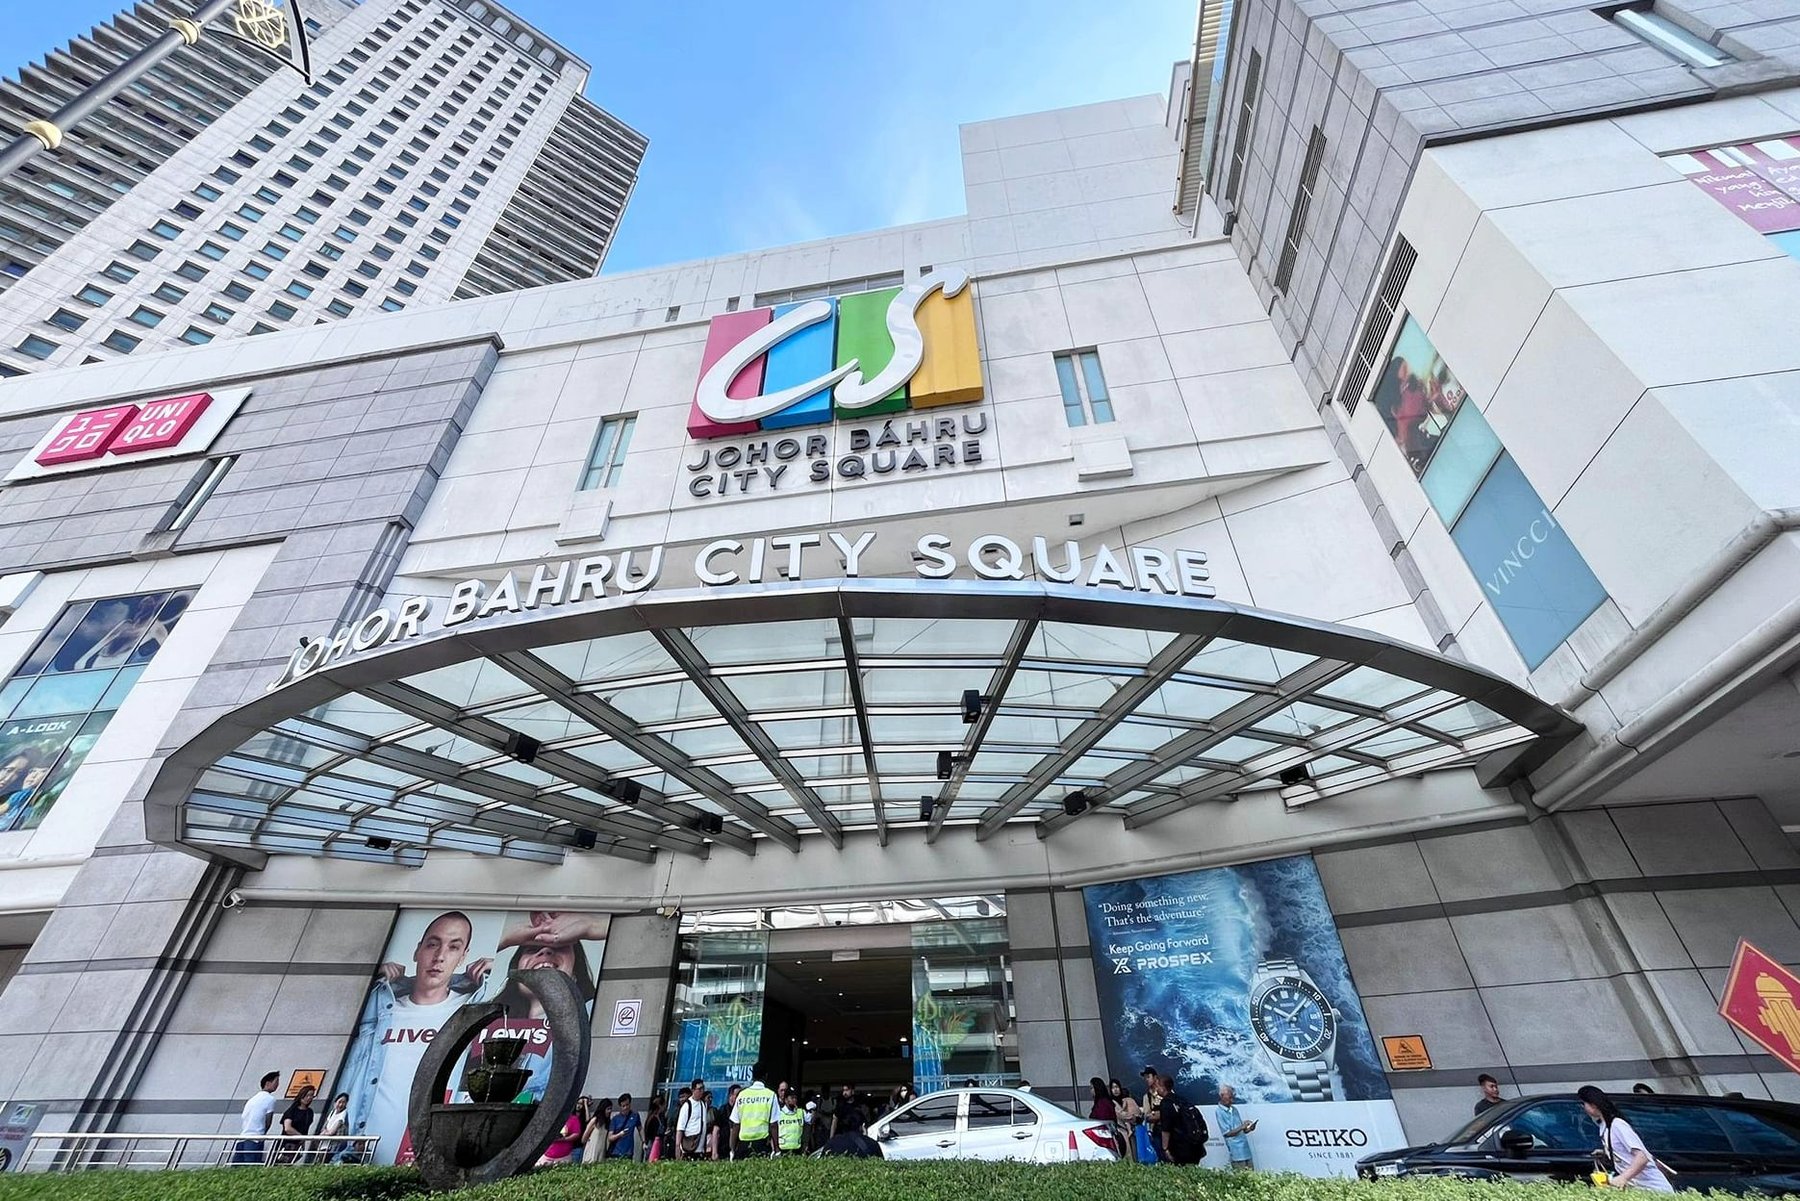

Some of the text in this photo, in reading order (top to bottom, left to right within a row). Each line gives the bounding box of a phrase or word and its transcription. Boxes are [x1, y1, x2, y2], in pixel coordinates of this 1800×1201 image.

[139, 400, 191, 423] UNI
[122, 419, 177, 444] QLO
[687, 412, 987, 472] JOHOR BAHRU
[688, 440, 983, 498] CITY SQUARE
[1485, 508, 1557, 596] VINCCI
[266, 531, 1216, 692] JOHOR BAHRU CITY SQUARE
[6, 720, 72, 736] A-LOOK
[1135, 895, 1186, 908] something
[1136, 913, 1152, 924] the
[1109, 934, 1209, 955] Keep Going Forward
[1137, 952, 1213, 970] PROSPEX
[738, 1096, 770, 1105] SECURITY
[1285, 1128, 1368, 1148] SEIKO
[1308, 1151, 1332, 1159] SINCE
